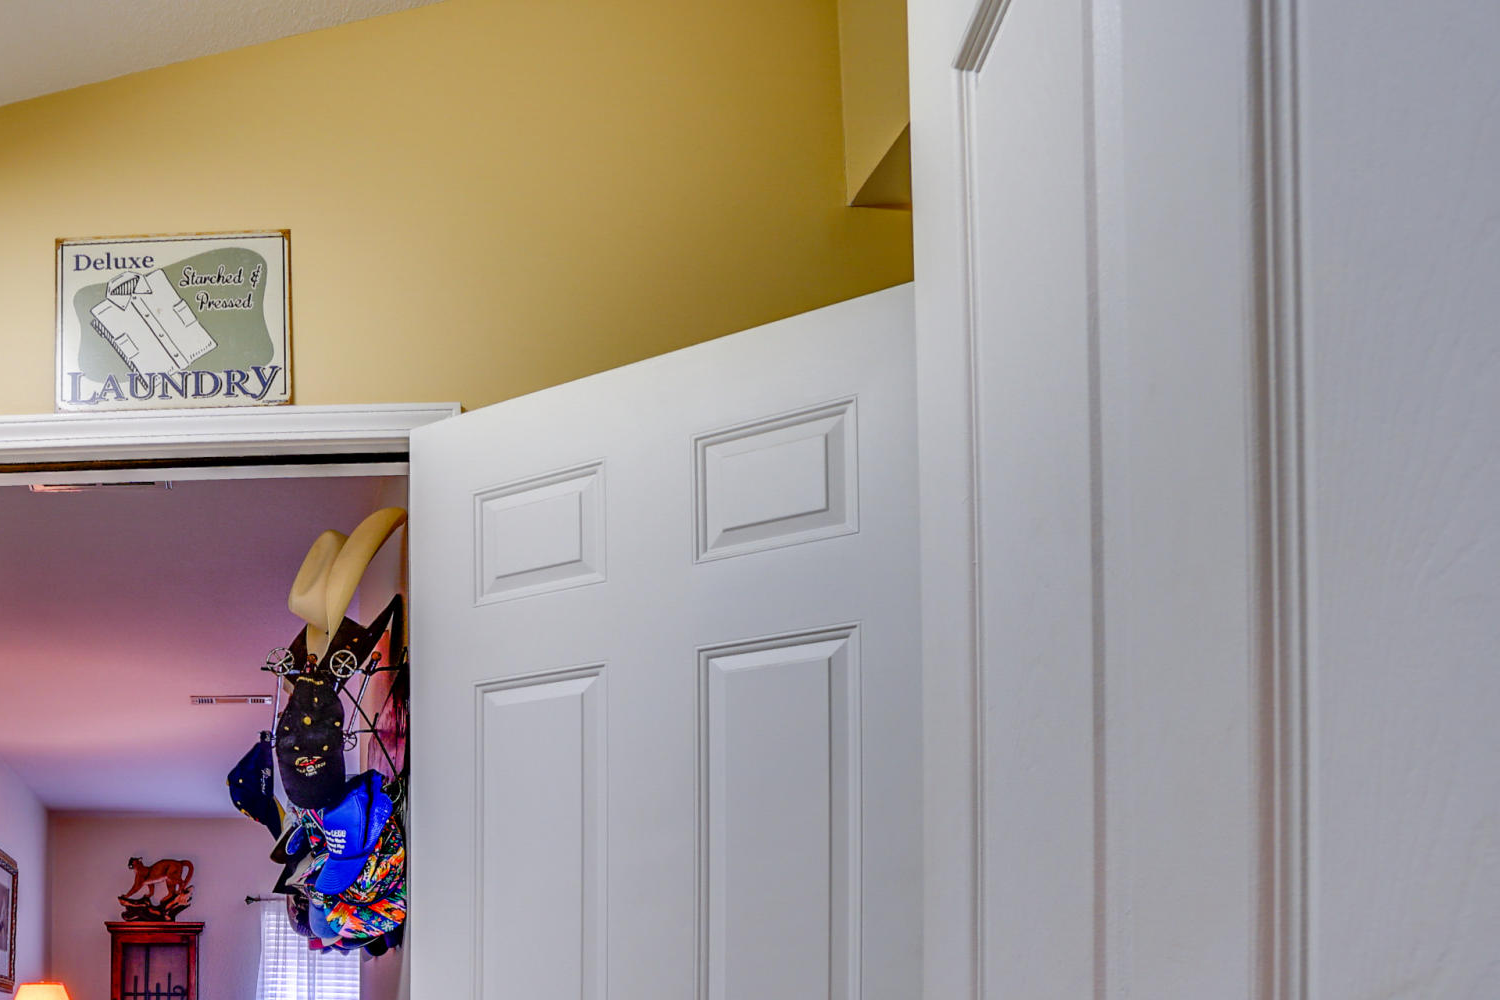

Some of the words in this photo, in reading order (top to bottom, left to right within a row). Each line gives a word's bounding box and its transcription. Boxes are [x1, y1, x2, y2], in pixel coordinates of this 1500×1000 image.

[72, 252, 155, 272] Deluxe
[179, 265, 243, 288] Starched
[250, 264, 262, 288] &
[195, 291, 253, 311] Pressed
[66, 364, 283, 406] LAUNDRY
